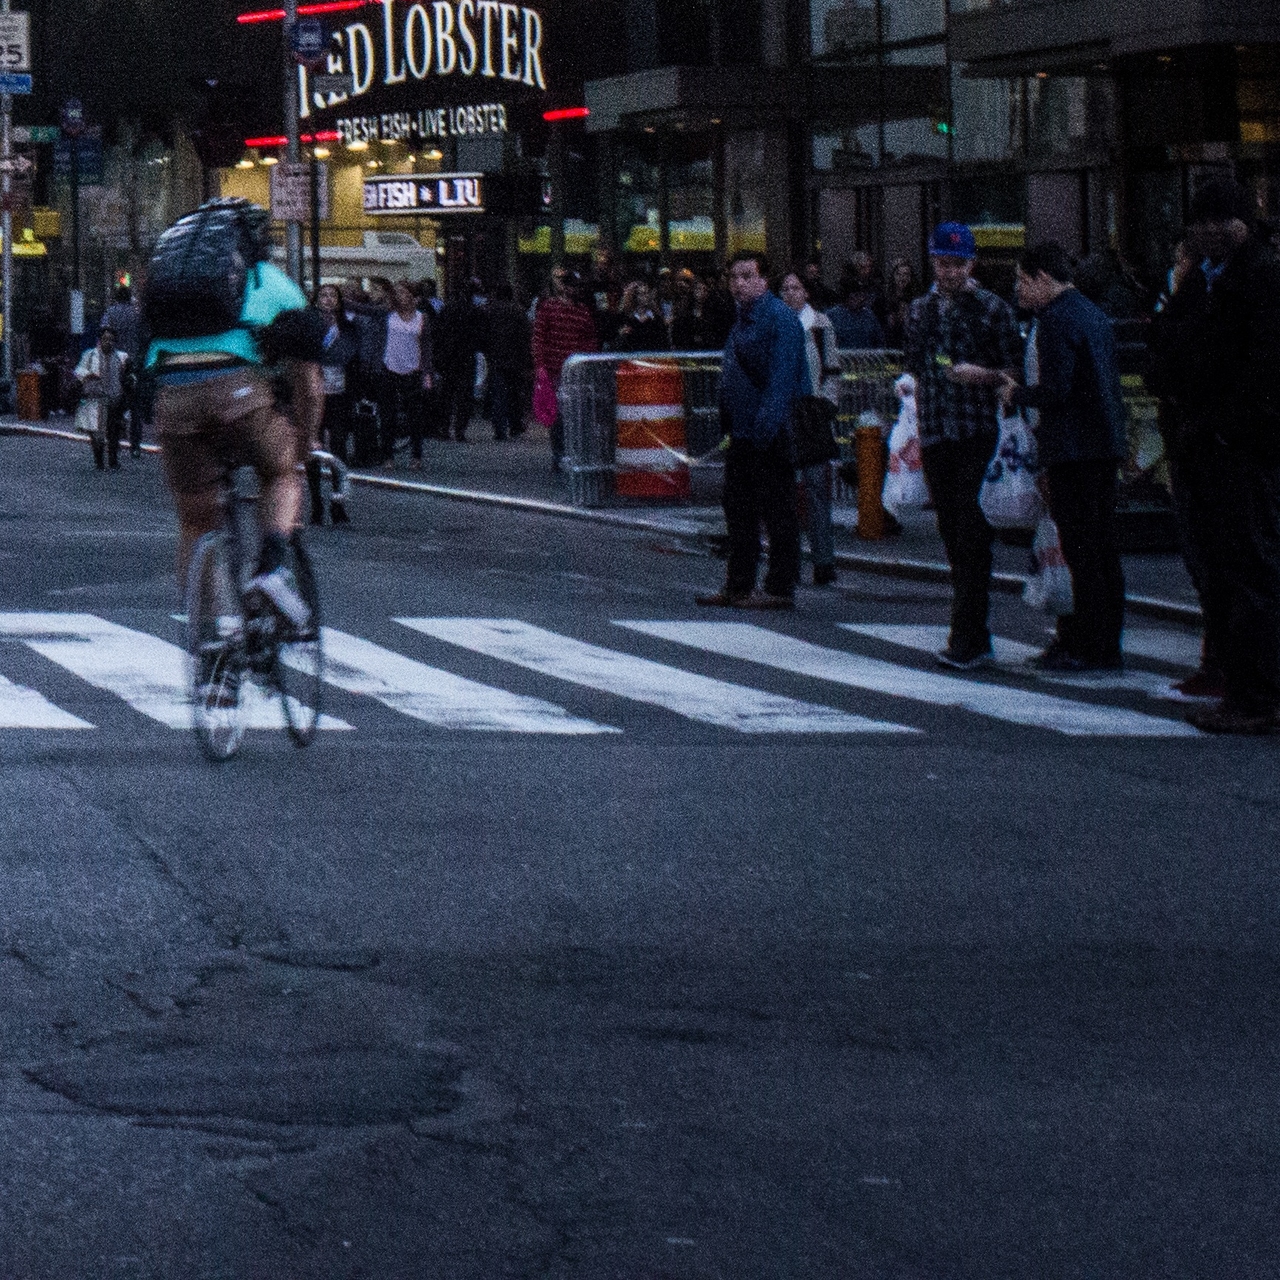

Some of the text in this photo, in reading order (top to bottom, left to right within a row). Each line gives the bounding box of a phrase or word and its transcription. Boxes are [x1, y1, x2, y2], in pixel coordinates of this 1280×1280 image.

[339, 103, 508, 145] FRESH FISH LIVE LOBSTER
[377, 181, 417, 207] FISH
